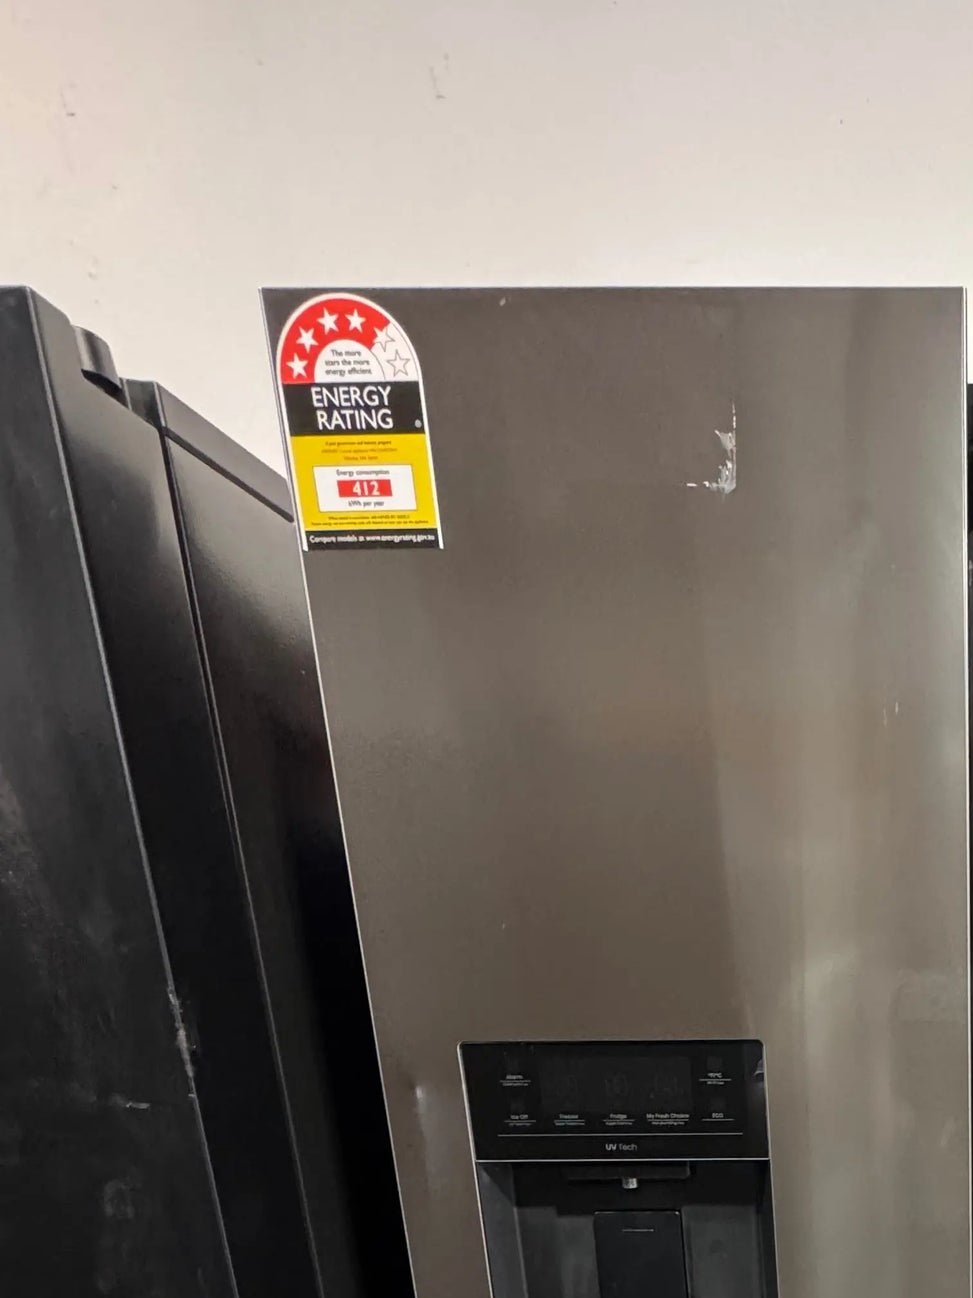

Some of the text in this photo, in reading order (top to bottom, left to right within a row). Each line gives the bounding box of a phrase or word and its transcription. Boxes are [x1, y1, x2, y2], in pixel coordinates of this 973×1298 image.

[331, 349, 344, 357] The
[325, 359, 340, 367] stars
[341, 358, 352, 366] the
[325, 367, 372, 377] energy efficient
[310, 385, 391, 407] ENERGY
[316, 408, 394, 430] RATING
[336, 469, 390, 477] Energy consumption
[352, 480, 380, 496] 412
[309, 535, 336, 544] Compare
[337, 534, 358, 542] models
[605, 1143, 638, 1151] UV Tech
